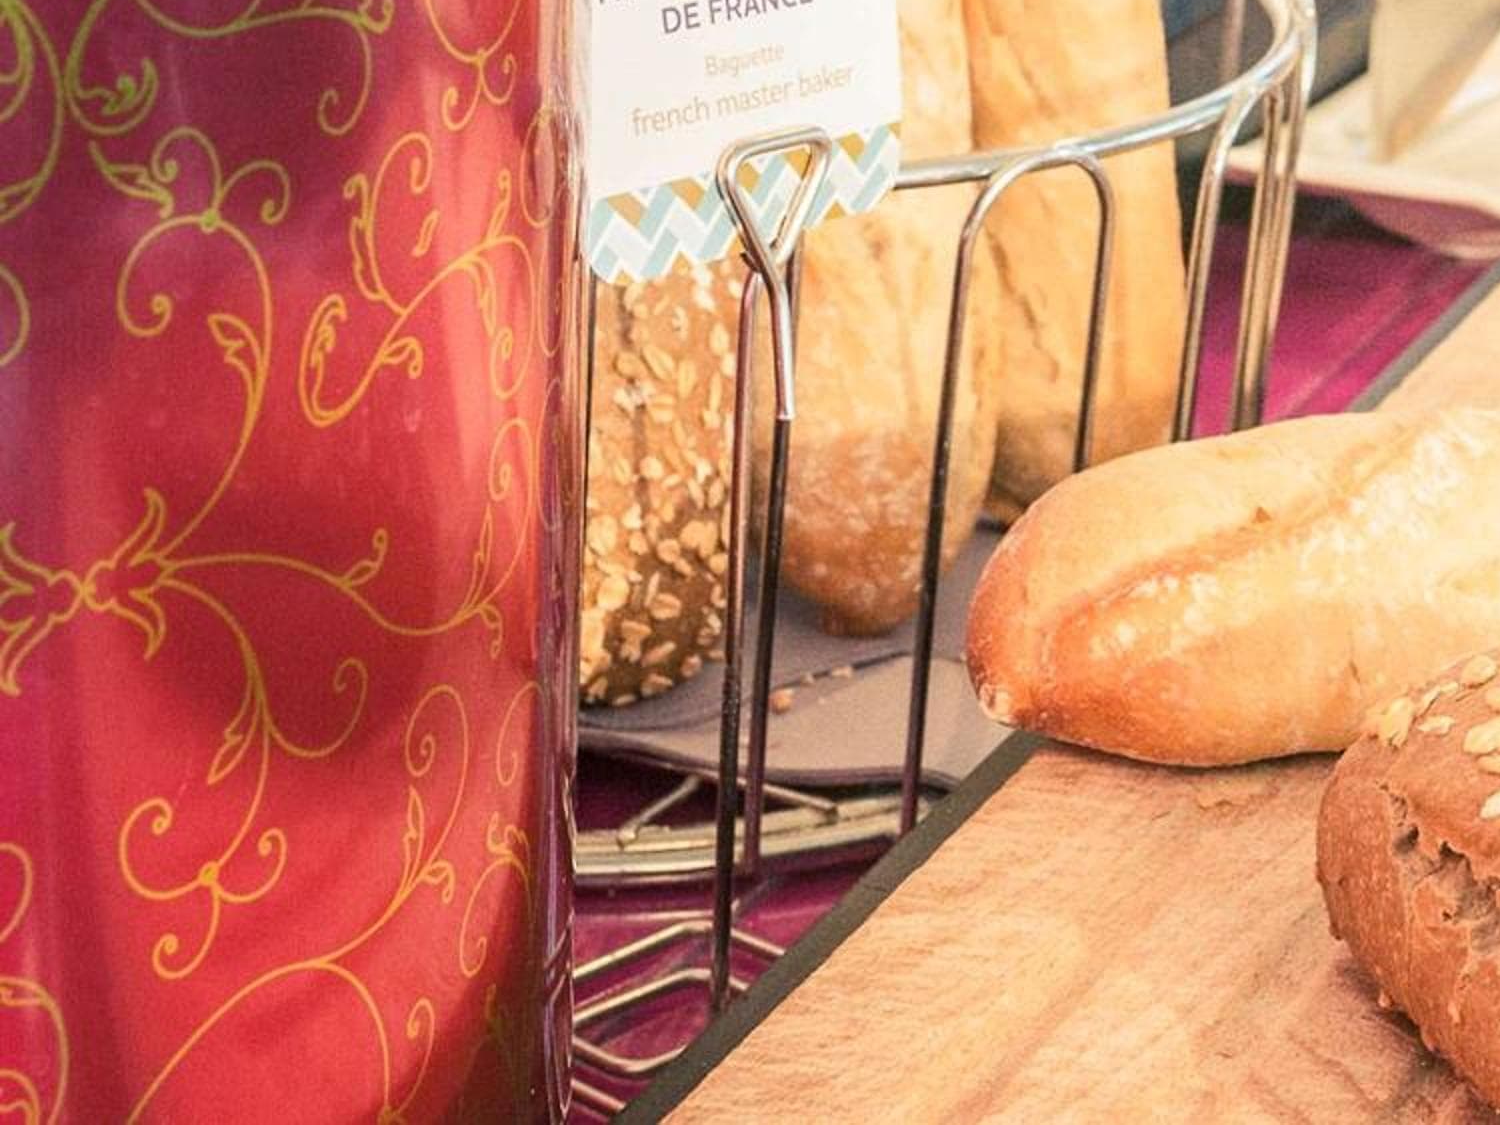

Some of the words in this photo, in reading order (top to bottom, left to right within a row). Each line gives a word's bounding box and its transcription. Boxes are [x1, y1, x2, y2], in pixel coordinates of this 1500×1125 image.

[661, 2, 701, 34] DE
[705, 43, 785, 79] Baguette
[631, 94, 711, 138] french
[716, 79, 794, 115] master
[799, 64, 854, 98] baker
